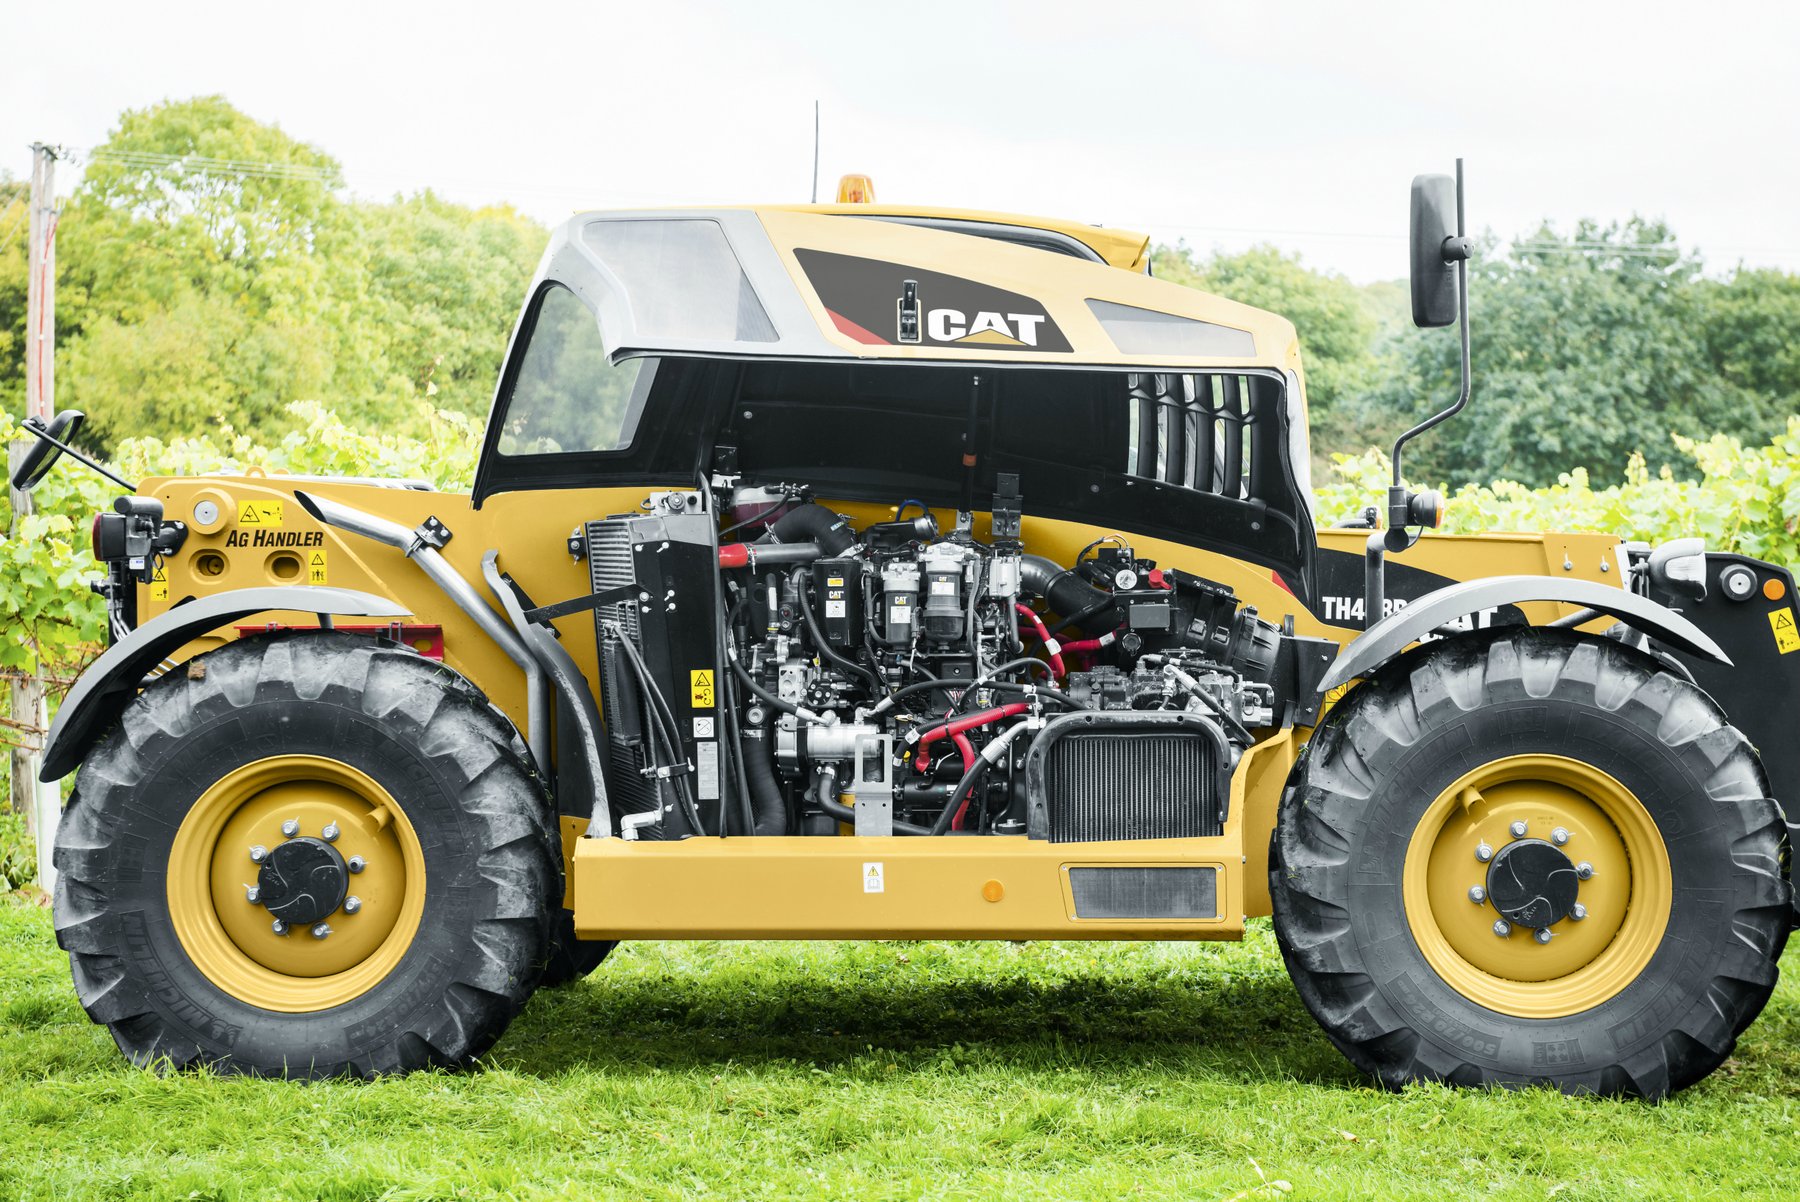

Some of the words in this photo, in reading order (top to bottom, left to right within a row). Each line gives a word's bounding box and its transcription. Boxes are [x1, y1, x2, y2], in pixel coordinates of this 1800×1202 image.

[928, 309, 1045, 346] CAT
[226, 530, 249, 547] AG
[253, 529, 324, 547] HANDLER
[829, 591, 843, 599] CAT
[895, 596, 907, 604] CAT
[120, 911, 211, 1034] MICHELIN
[1432, 1017, 1496, 1056] 500/70
